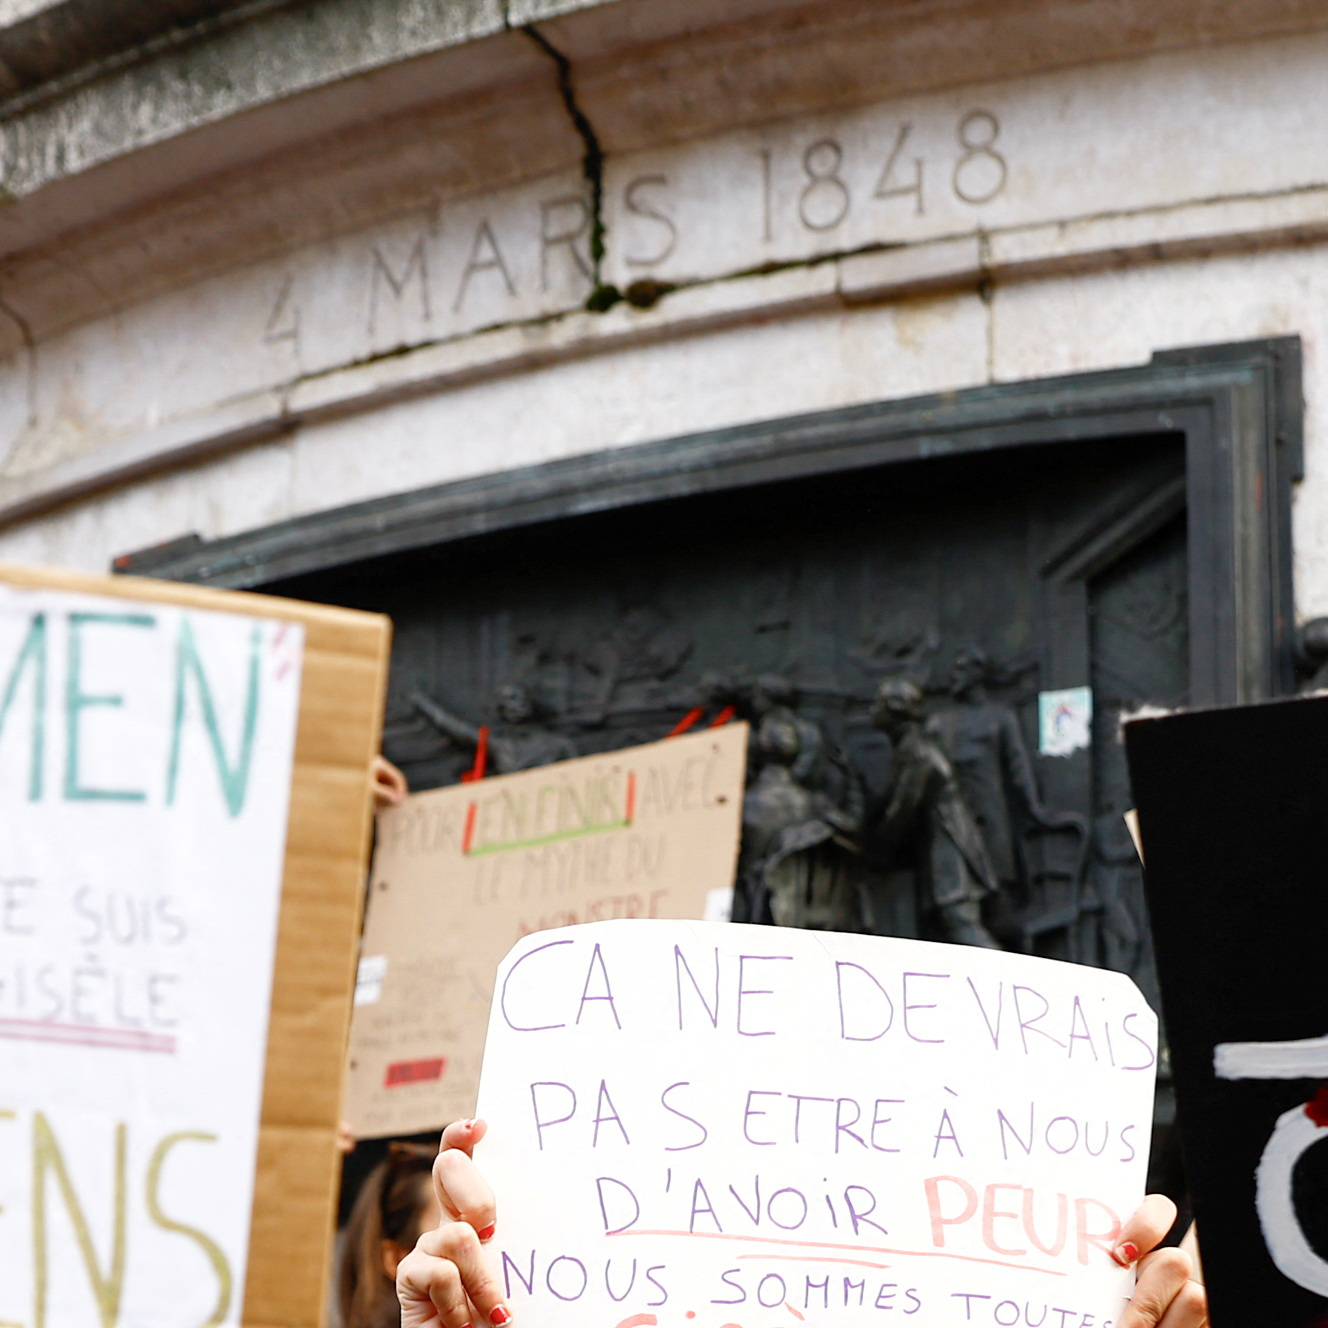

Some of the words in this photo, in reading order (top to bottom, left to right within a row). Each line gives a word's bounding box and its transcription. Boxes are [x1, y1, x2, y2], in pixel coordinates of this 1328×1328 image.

[370, 173, 678, 332] MARS
[757, 110, 1008, 244] 1848
[74, 883, 189, 946] SUIS
[501, 939, 622, 1032] CA
[673, 943, 794, 1037] NE
[528, 1078, 709, 1151] PAS
[742, 1090, 906, 1154] ETRE
[932, 1085, 964, 1160] À
[996, 1101, 1136, 1162] NOUS
[923, 1174, 1124, 1267] PEUR
[501, 1249, 669, 1307] NOUS
[709, 1267, 922, 1315] SOMMES
